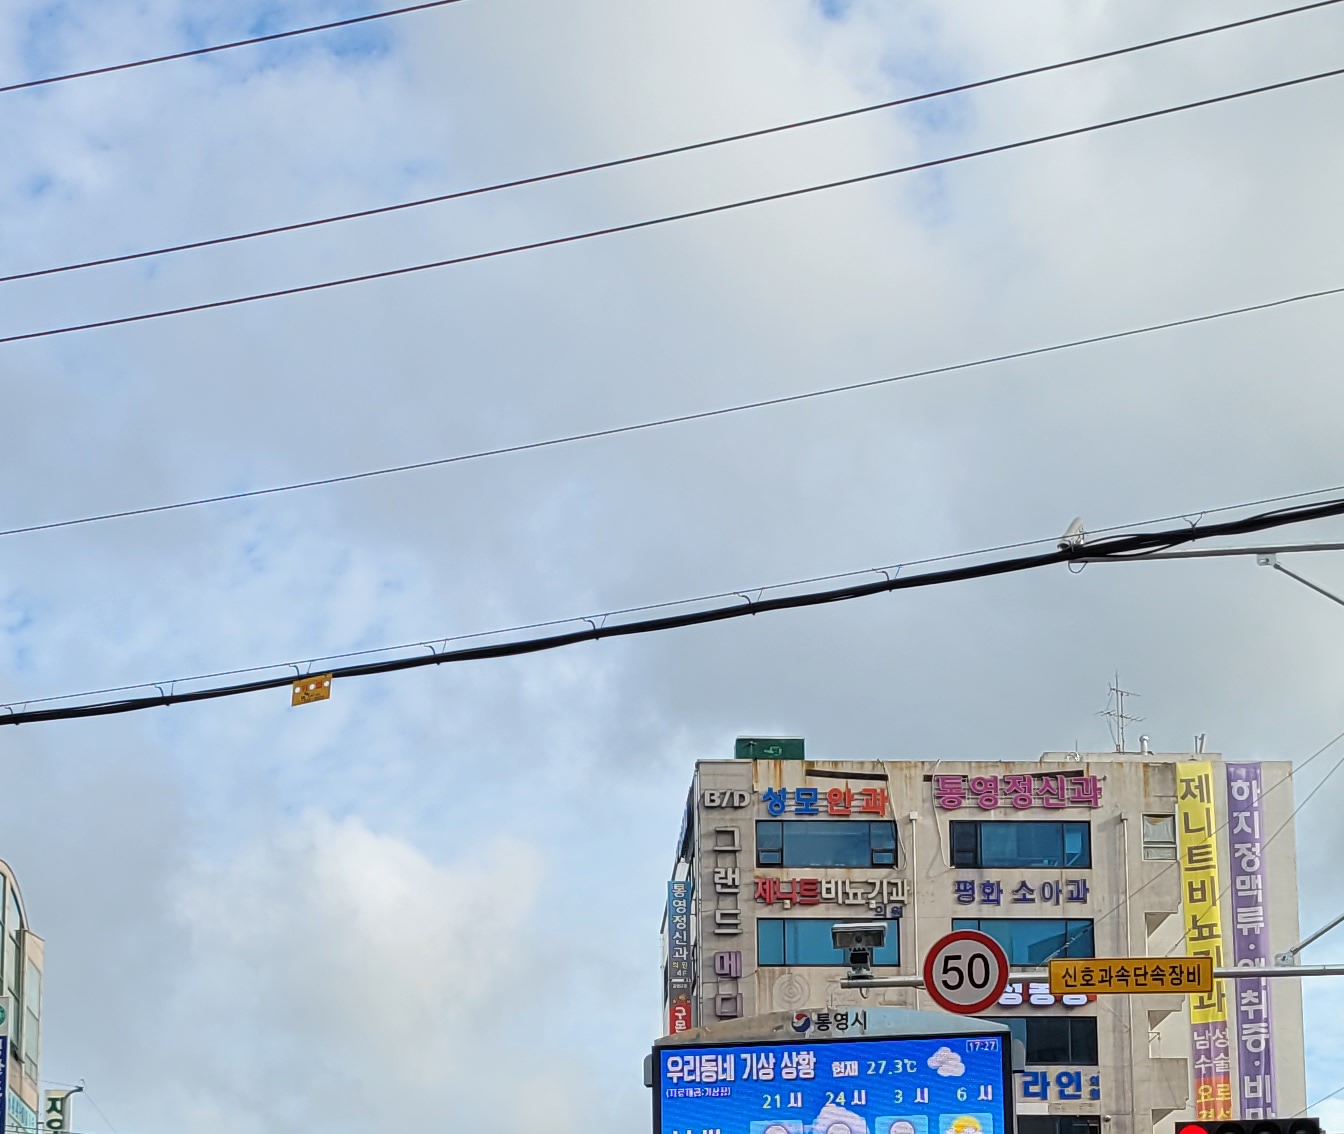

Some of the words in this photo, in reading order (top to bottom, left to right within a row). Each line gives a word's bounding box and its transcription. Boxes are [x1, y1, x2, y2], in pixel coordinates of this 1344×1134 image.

[704, 790, 751, 808] B/D
[935, 774, 1103, 811] 통영정신과
[755, 878, 911, 905] 제니트비뇨기과
[956, 879, 1001, 905] 평화
[1012, 879, 1090, 904] 소아과
[672, 884, 689, 960] 통영정신과
[941, 954, 991, 992] 50
[1062, 959, 1200, 987] 신호과속단속장비
[814, 1011, 867, 1031] 통영시
[969, 1041, 996, 1051] 17:27
[667, 1053, 735, 1084] 우리동네
[741, 1052, 776, 1081] 기상
[781, 1051, 816, 1080] 상황
[762, 1093, 781, 1109] 21
[825, 1091, 846, 1106] 24
[957, 1087, 967, 1102] 6
